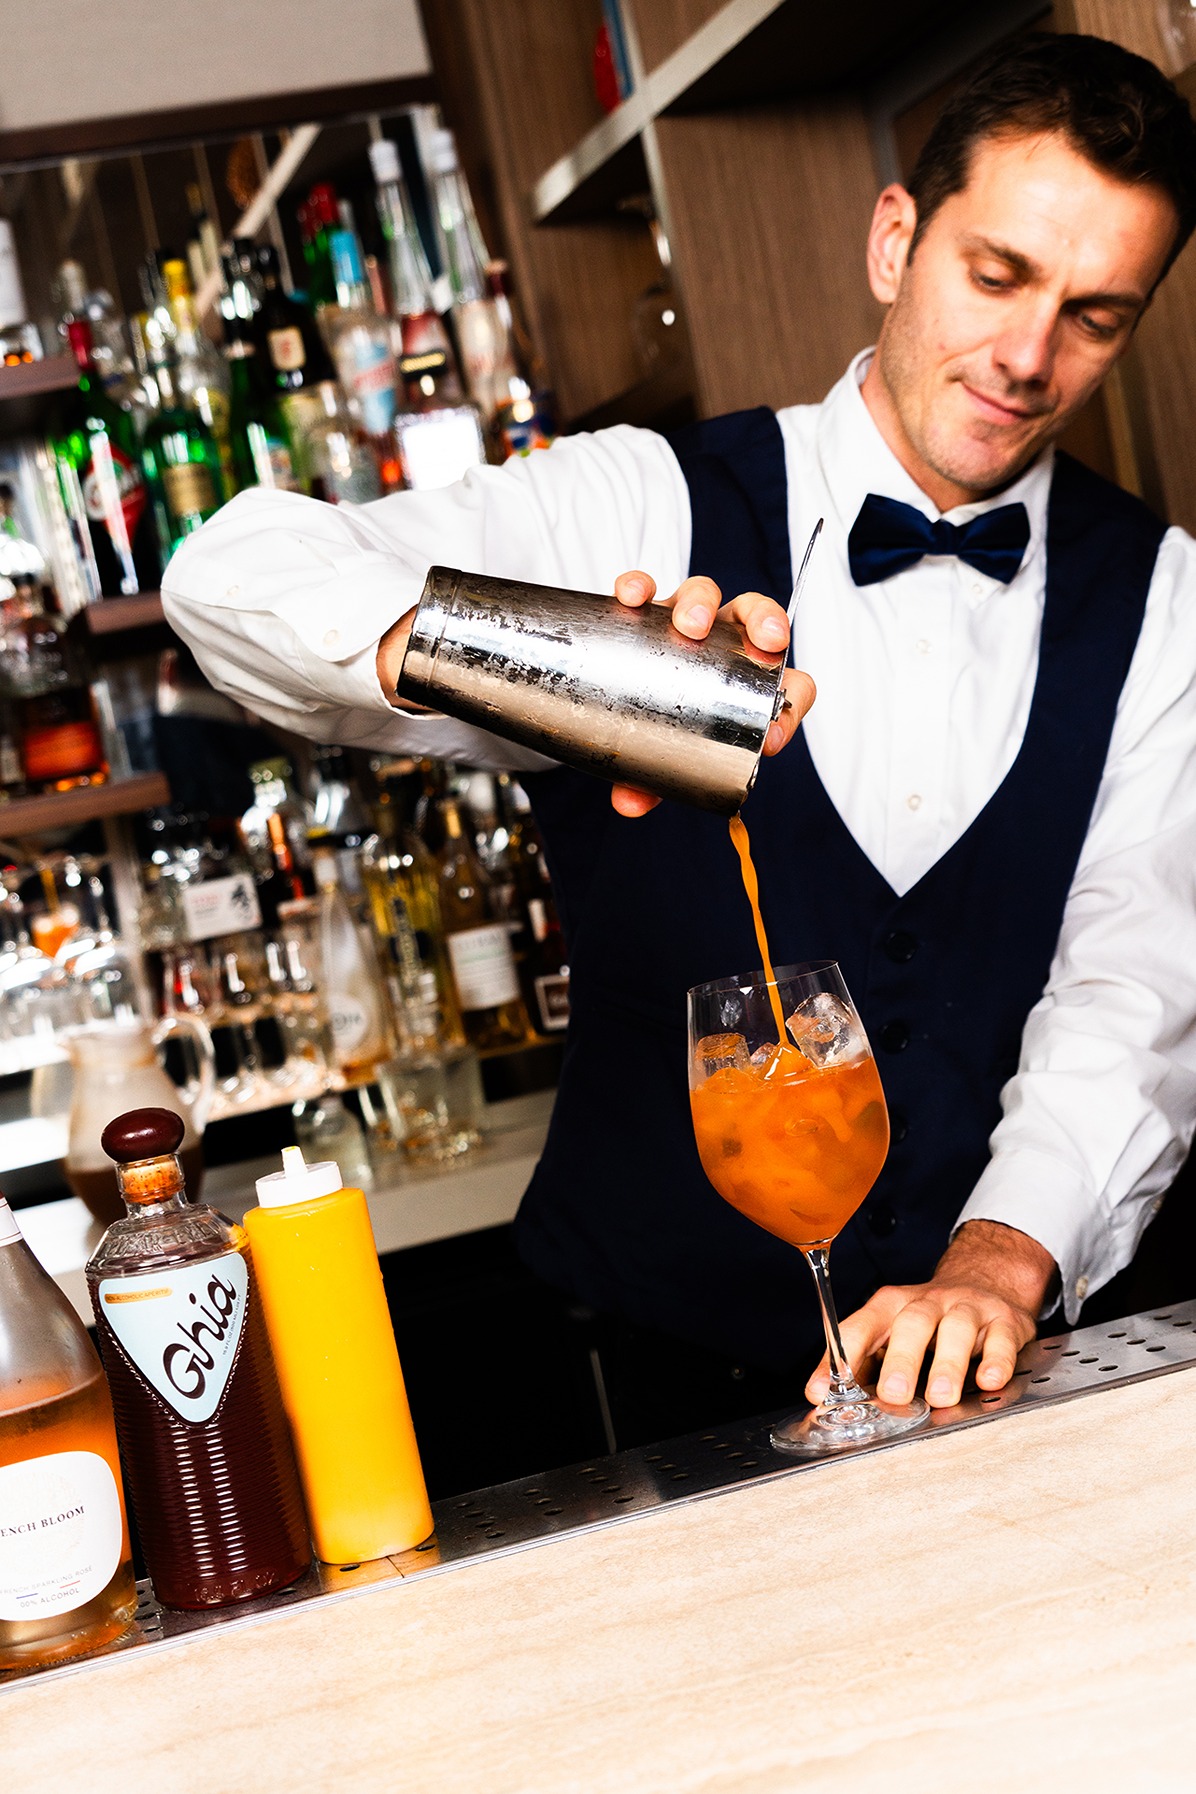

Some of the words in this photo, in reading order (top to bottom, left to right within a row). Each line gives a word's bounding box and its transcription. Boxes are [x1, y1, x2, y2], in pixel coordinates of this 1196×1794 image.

[162, 1273, 237, 1400] Ghia
[0, 1522, 37, 1537] ENCH
[41, 1505, 85, 1528] BLOOM
[41, 1588, 80, 1603] ALCOHOL
